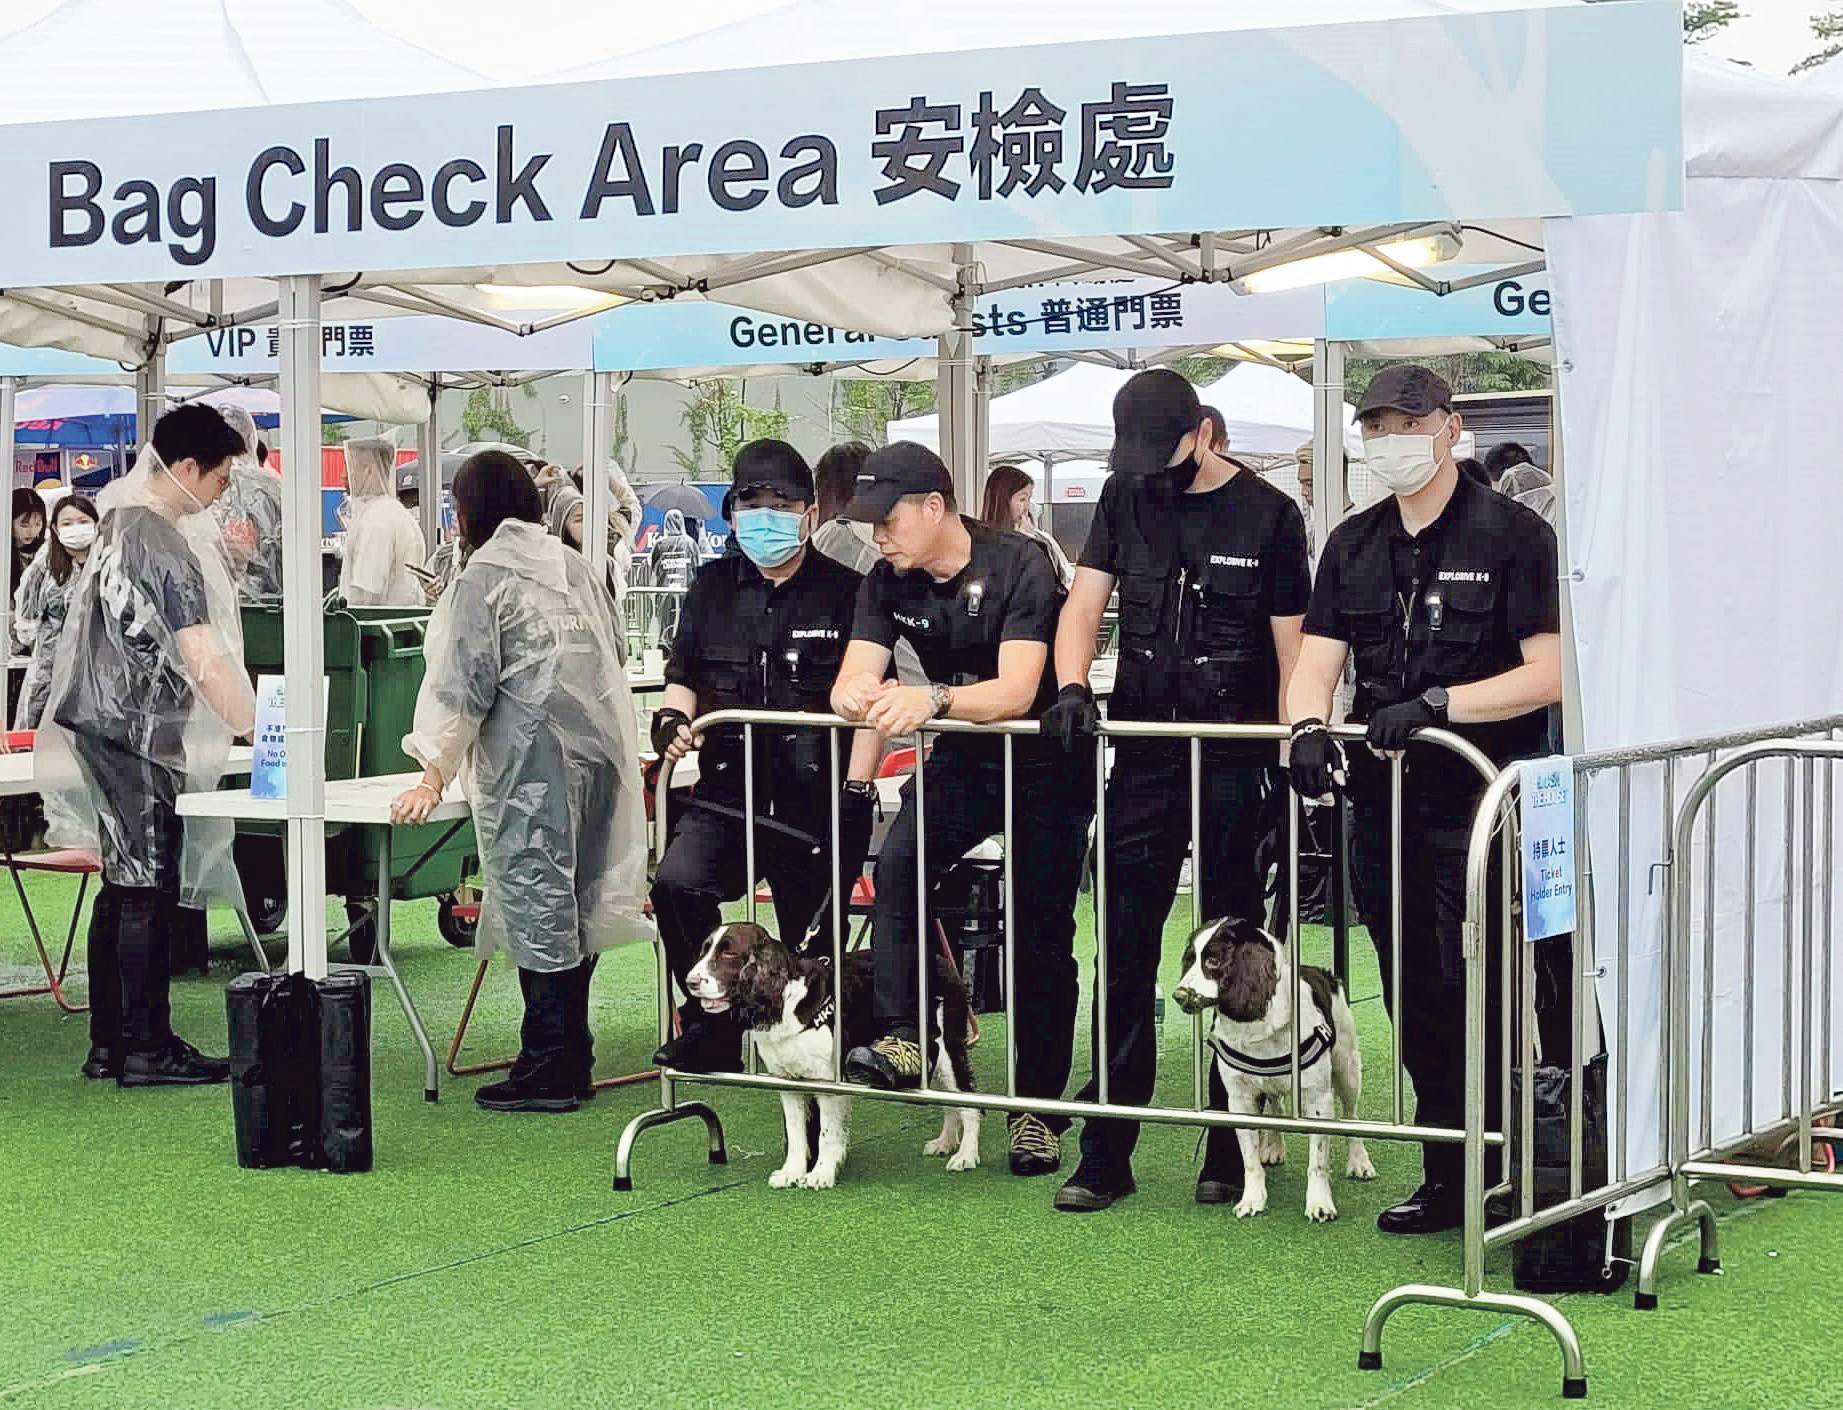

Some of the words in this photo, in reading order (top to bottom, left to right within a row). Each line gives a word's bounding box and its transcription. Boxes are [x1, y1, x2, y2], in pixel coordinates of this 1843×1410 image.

[49, 160, 217, 266] Bag
[246, 125, 553, 238] Check
[579, 122, 839, 216] Area
[872, 82, 1175, 206] 安檢處
[1041, 293, 1183, 334] 普通門票
[206, 327, 255, 357] VIP
[261, 759, 280, 768] Food
[267, 749, 278, 758] No
[1532, 837, 1566, 860] 持票人士
[1540, 866, 1562, 881] Ticket
[1530, 886, 1553, 901] Holder
[1554, 882, 1573, 897] Entry
